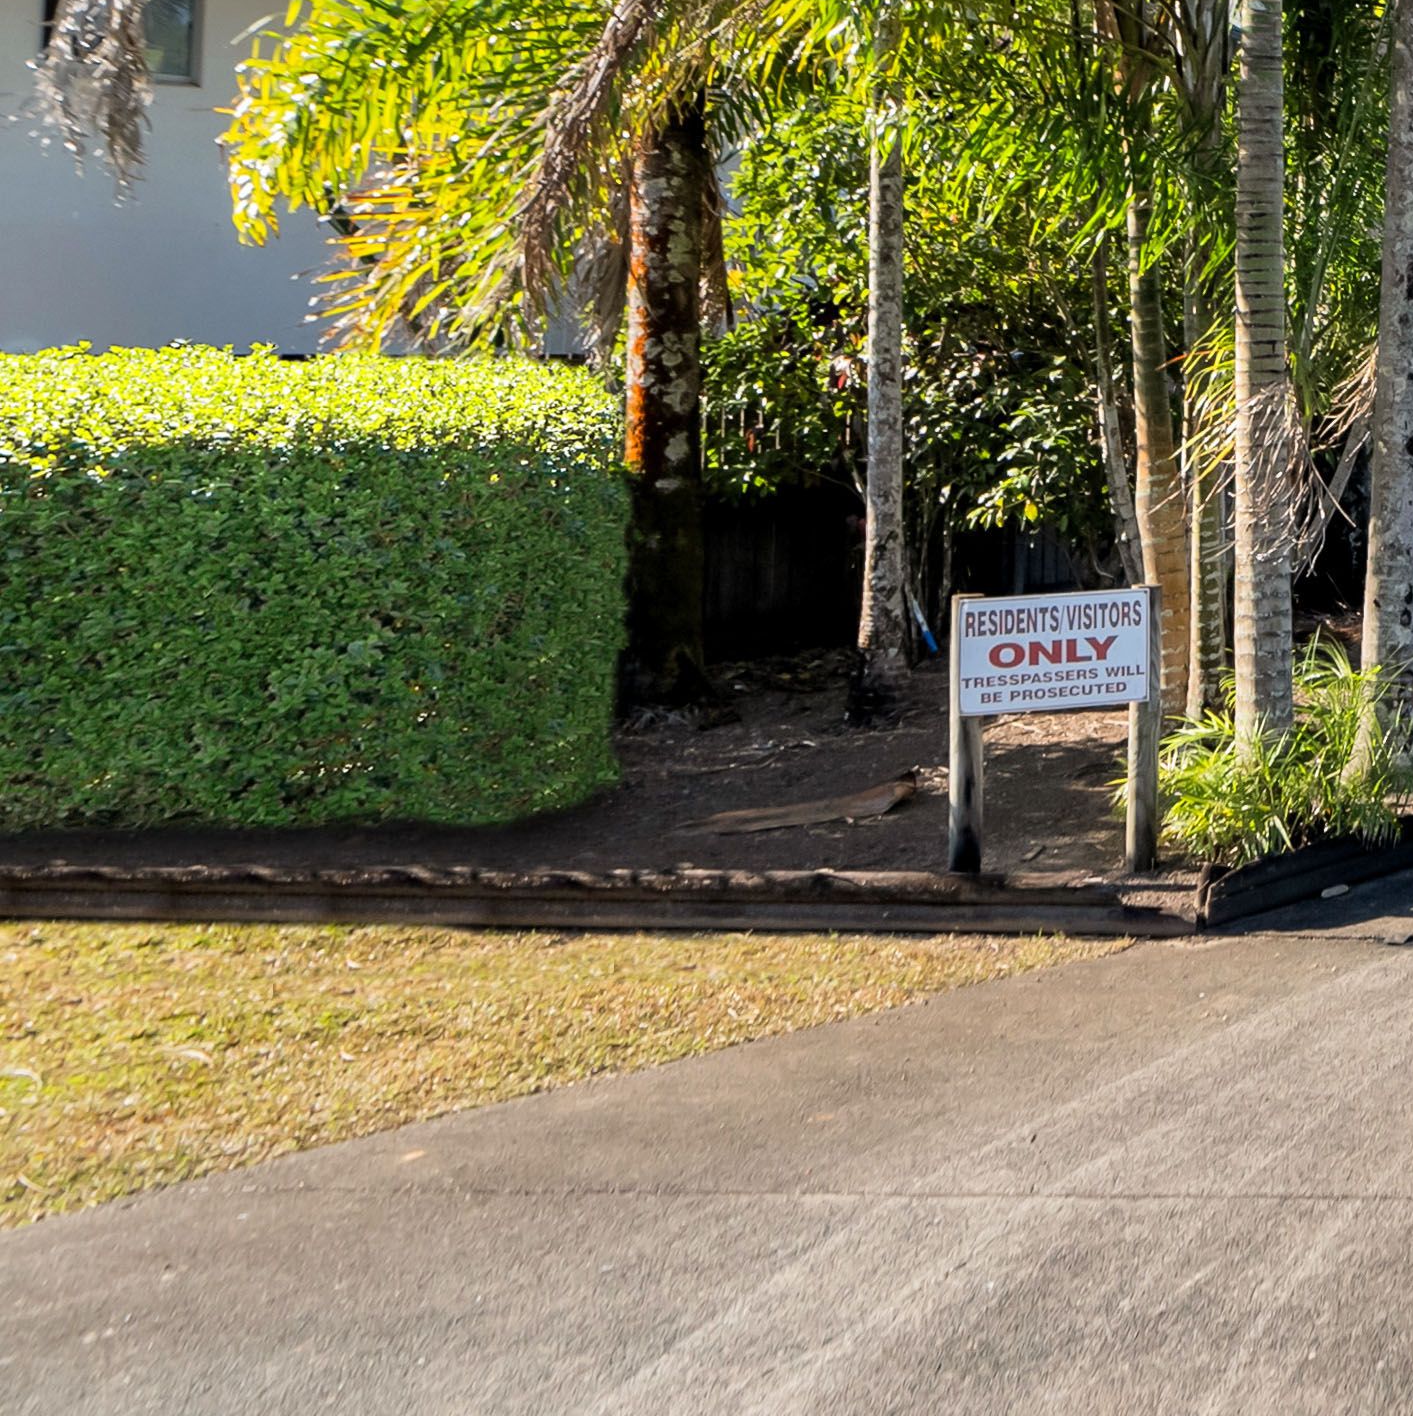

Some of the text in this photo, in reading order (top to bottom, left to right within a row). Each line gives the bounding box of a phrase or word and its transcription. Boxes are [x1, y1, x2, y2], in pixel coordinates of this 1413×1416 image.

[965, 600, 1142, 637] RESIDENTS/VISITORS
[989, 635, 1118, 669] ONLY
[961, 665, 1145, 689] TRESSPASSERS WILL
[980, 682, 1127, 704] BE PROSECUTED
